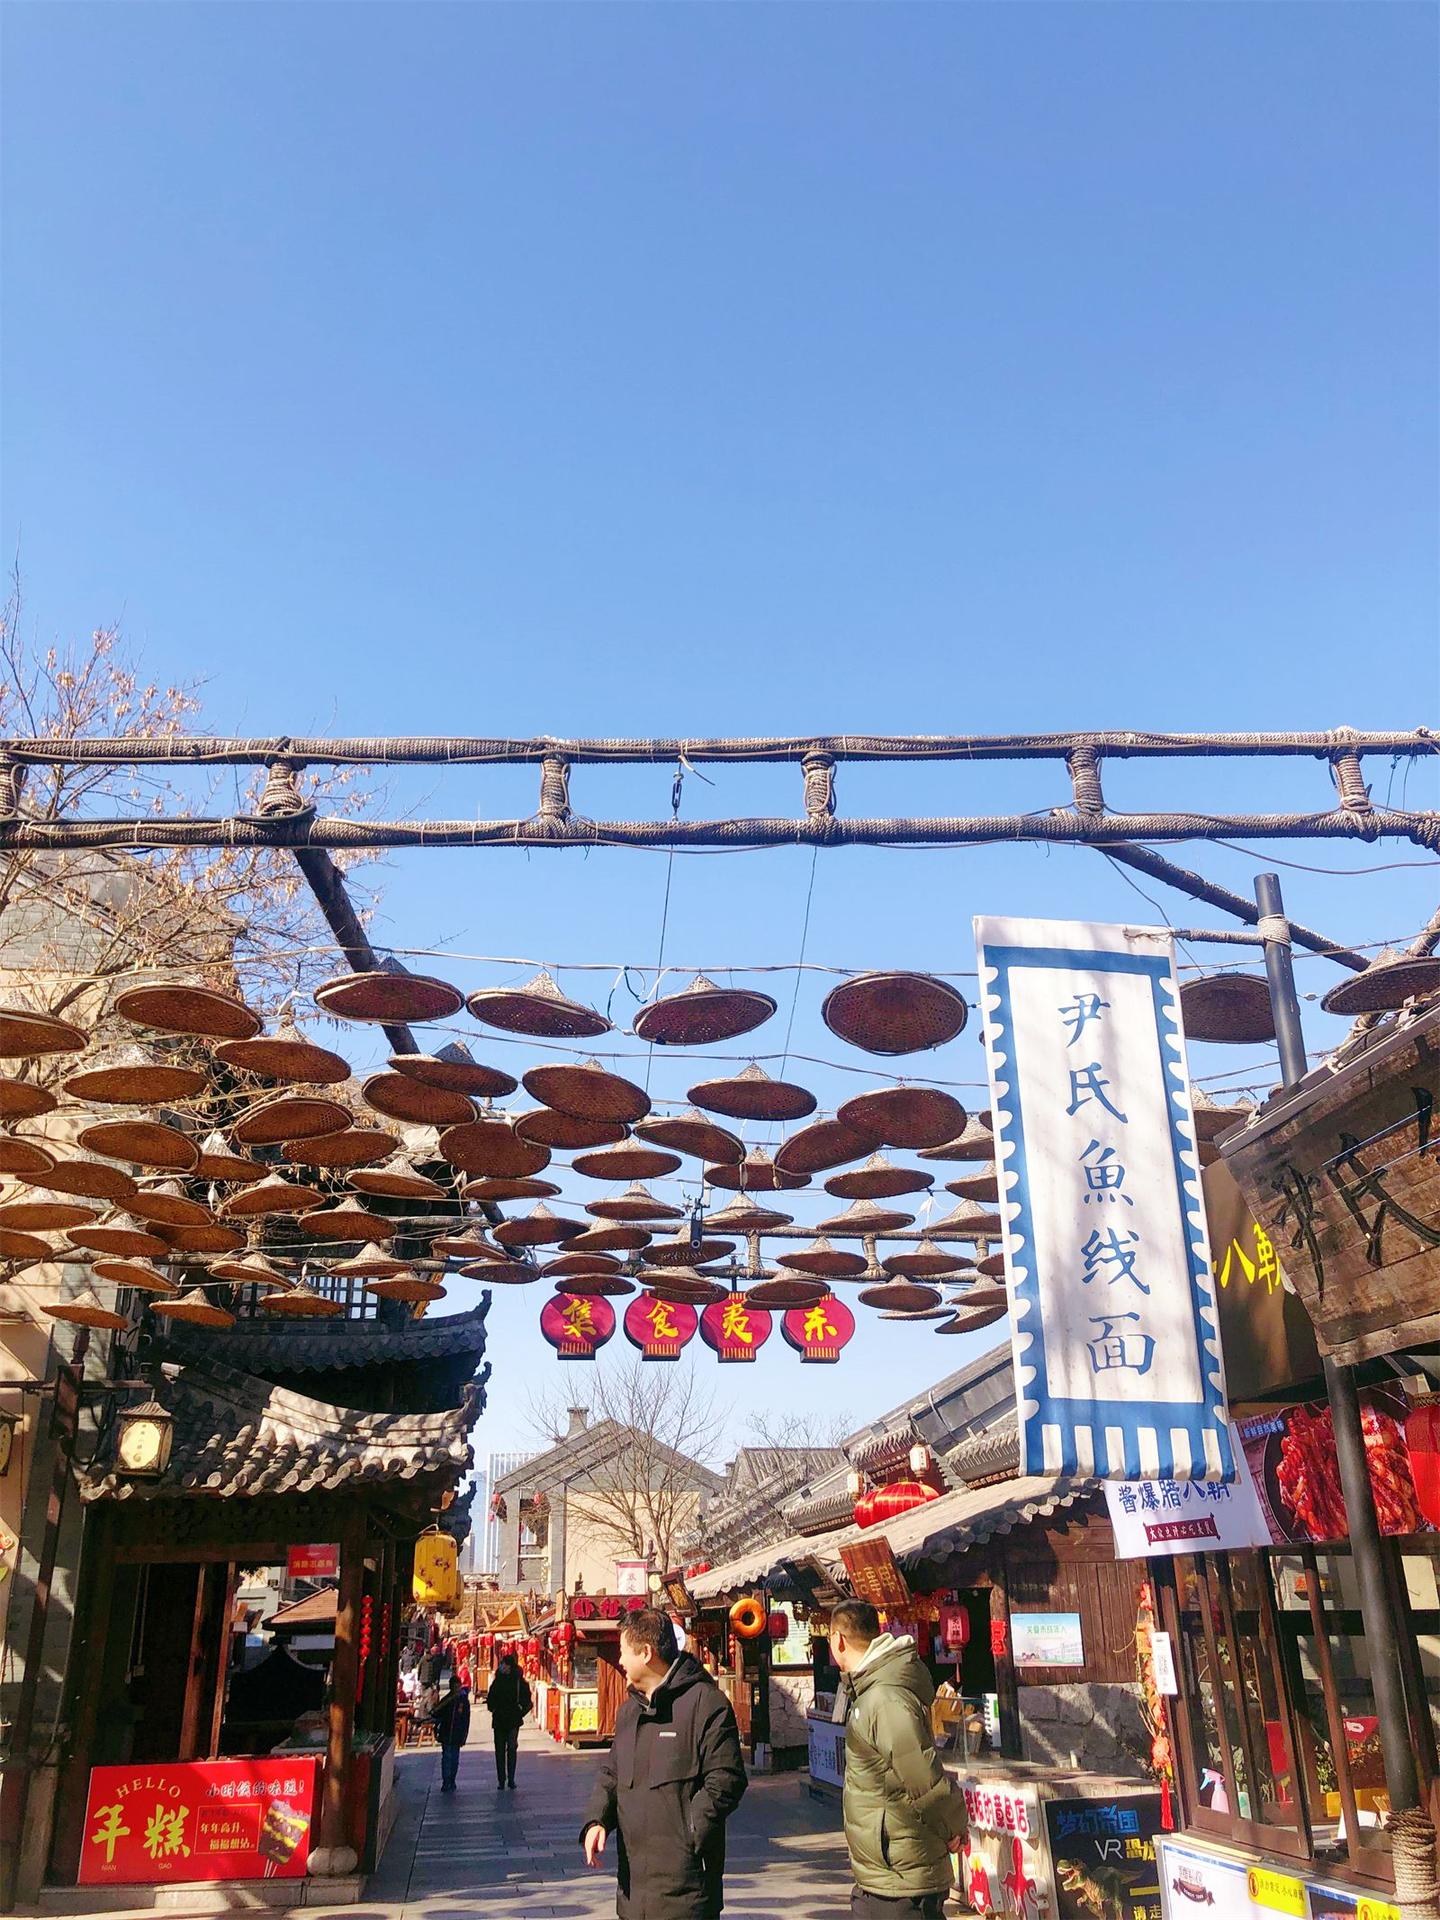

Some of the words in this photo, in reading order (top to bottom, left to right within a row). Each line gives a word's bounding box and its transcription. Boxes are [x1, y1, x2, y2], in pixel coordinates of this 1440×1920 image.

[1058, 992, 1156, 1376] 尹氏魚线面
[116, 1777, 181, 1799] HELLO
[91, 1803, 191, 1863] 年糕
[1094, 1838, 1124, 1861] VR
